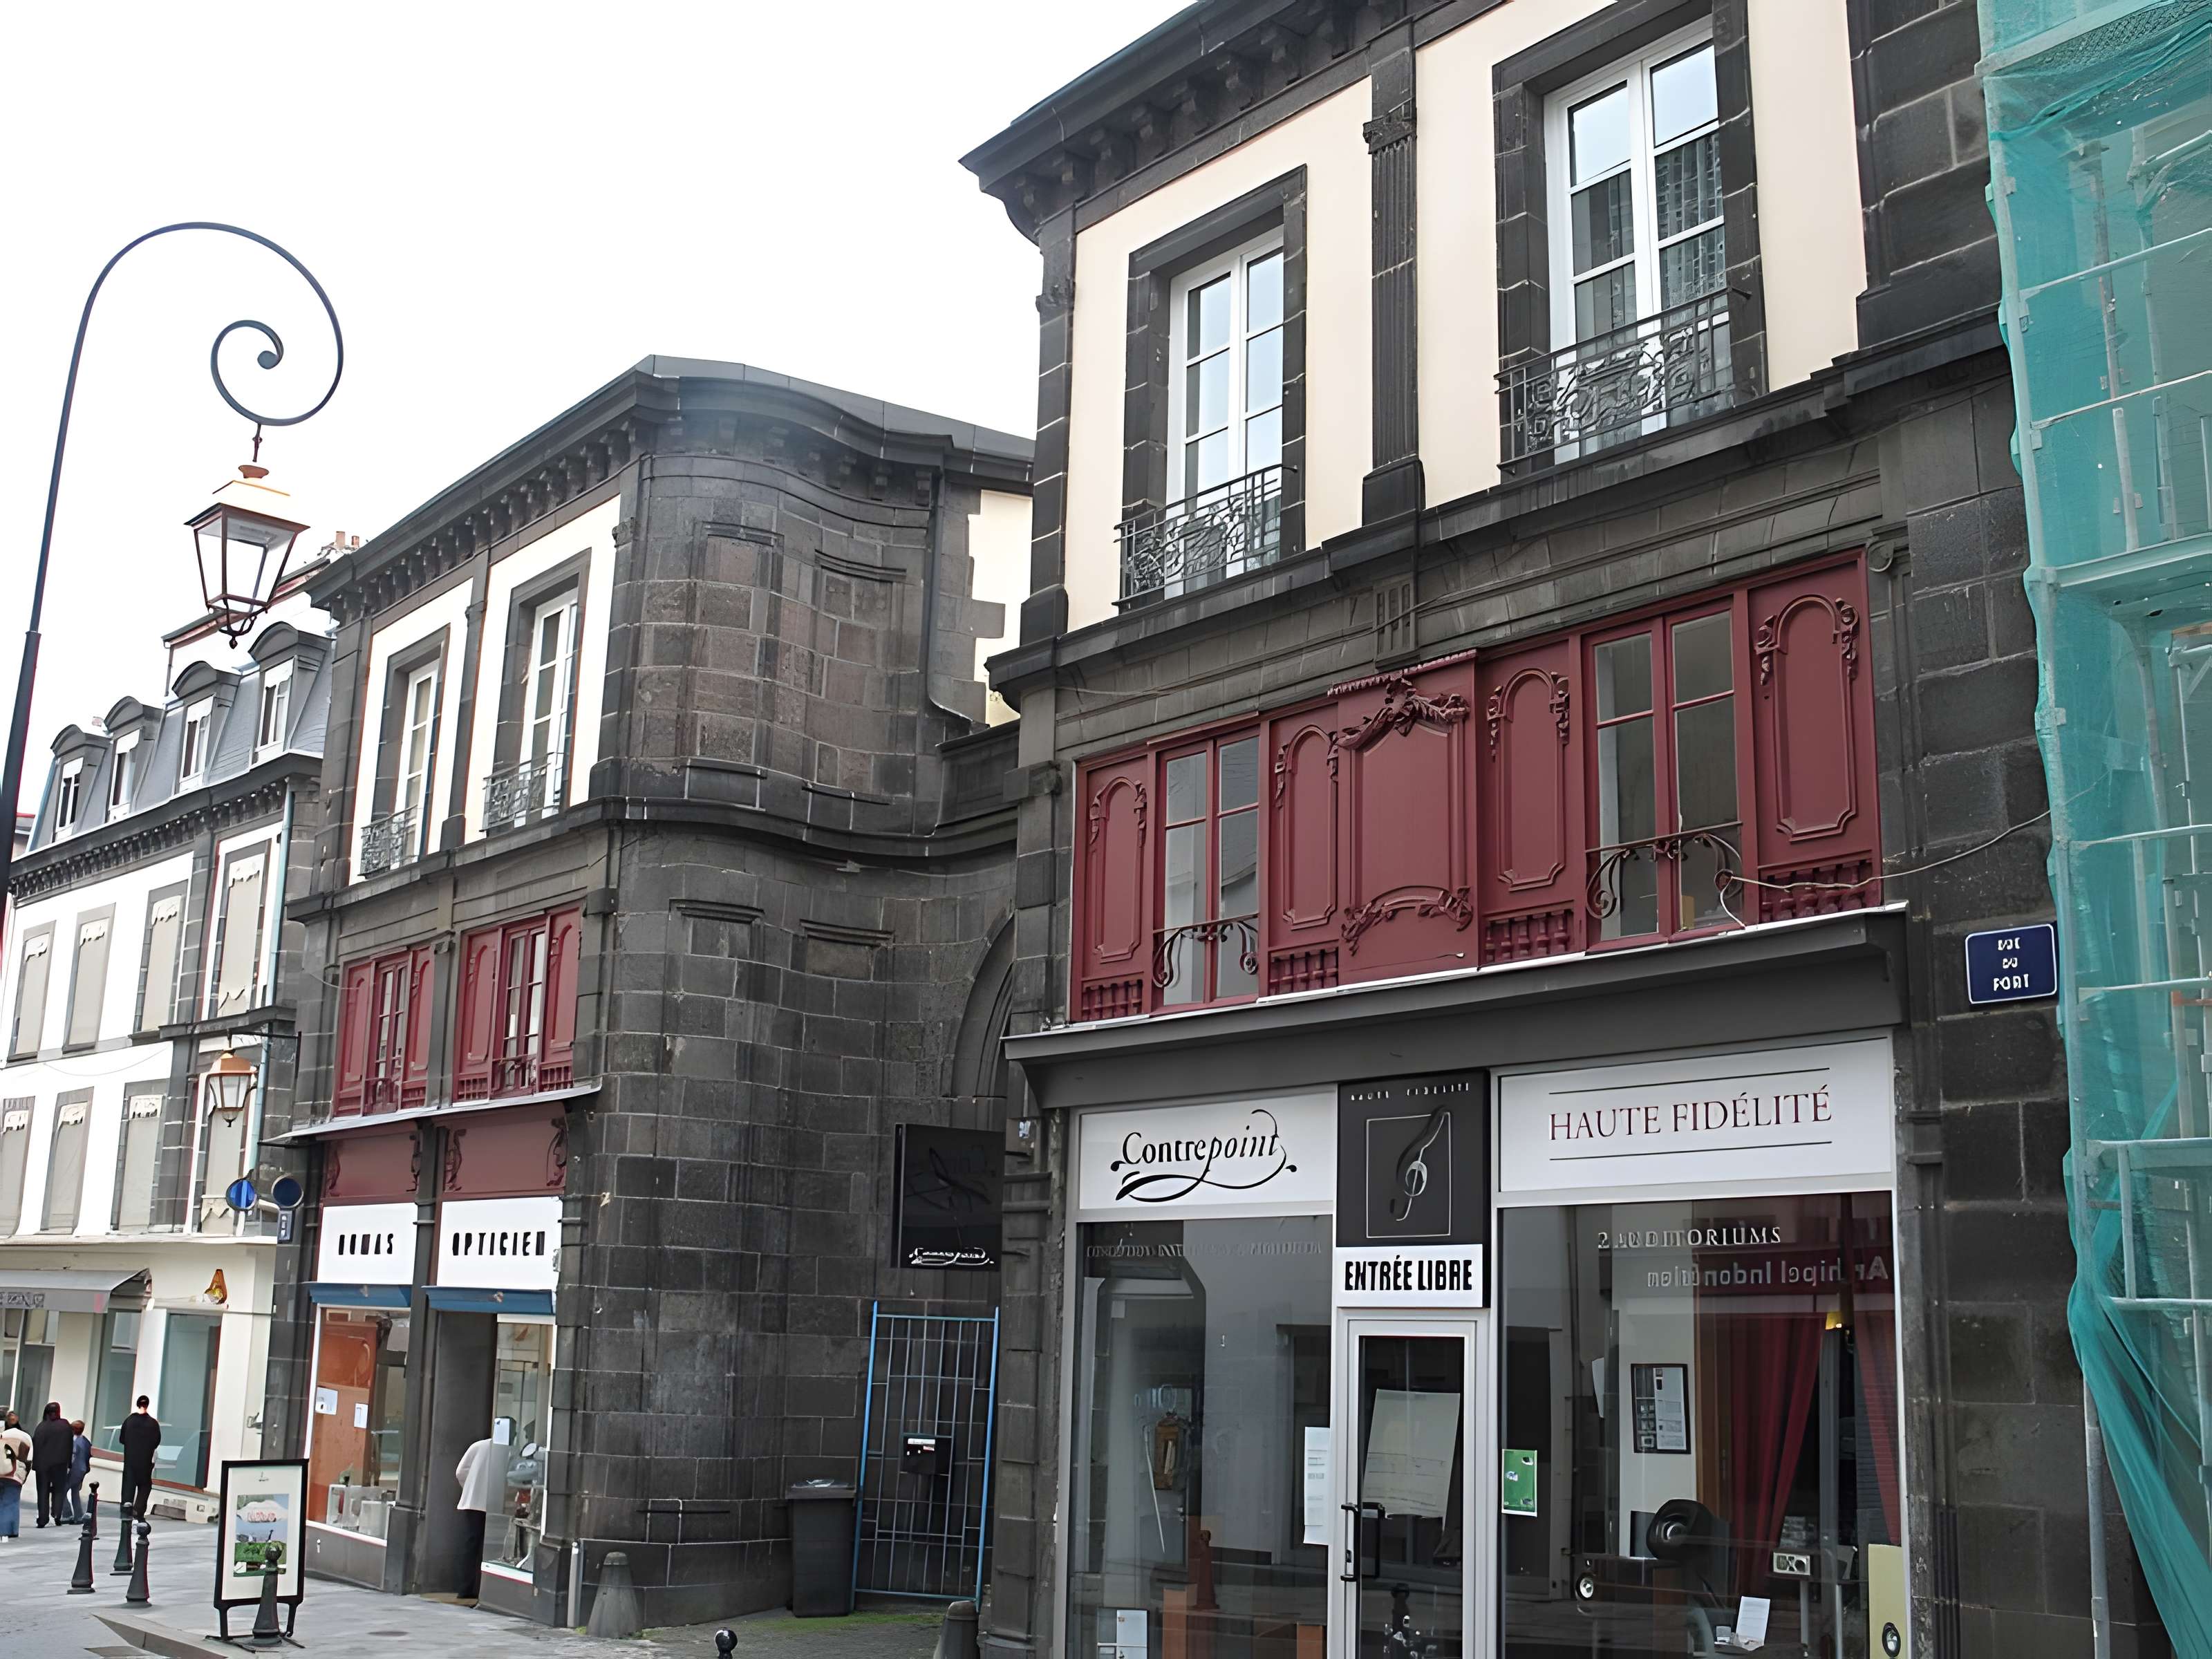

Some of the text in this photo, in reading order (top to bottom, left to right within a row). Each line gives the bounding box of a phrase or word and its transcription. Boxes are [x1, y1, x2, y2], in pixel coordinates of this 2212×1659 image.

[1549, 1084, 1833, 1141] HAUTE FIDÉLITÉ
[1111, 1109, 1295, 1187] Contrepoint
[1344, 1255, 1472, 1291] ENTRÉE LIBRE
